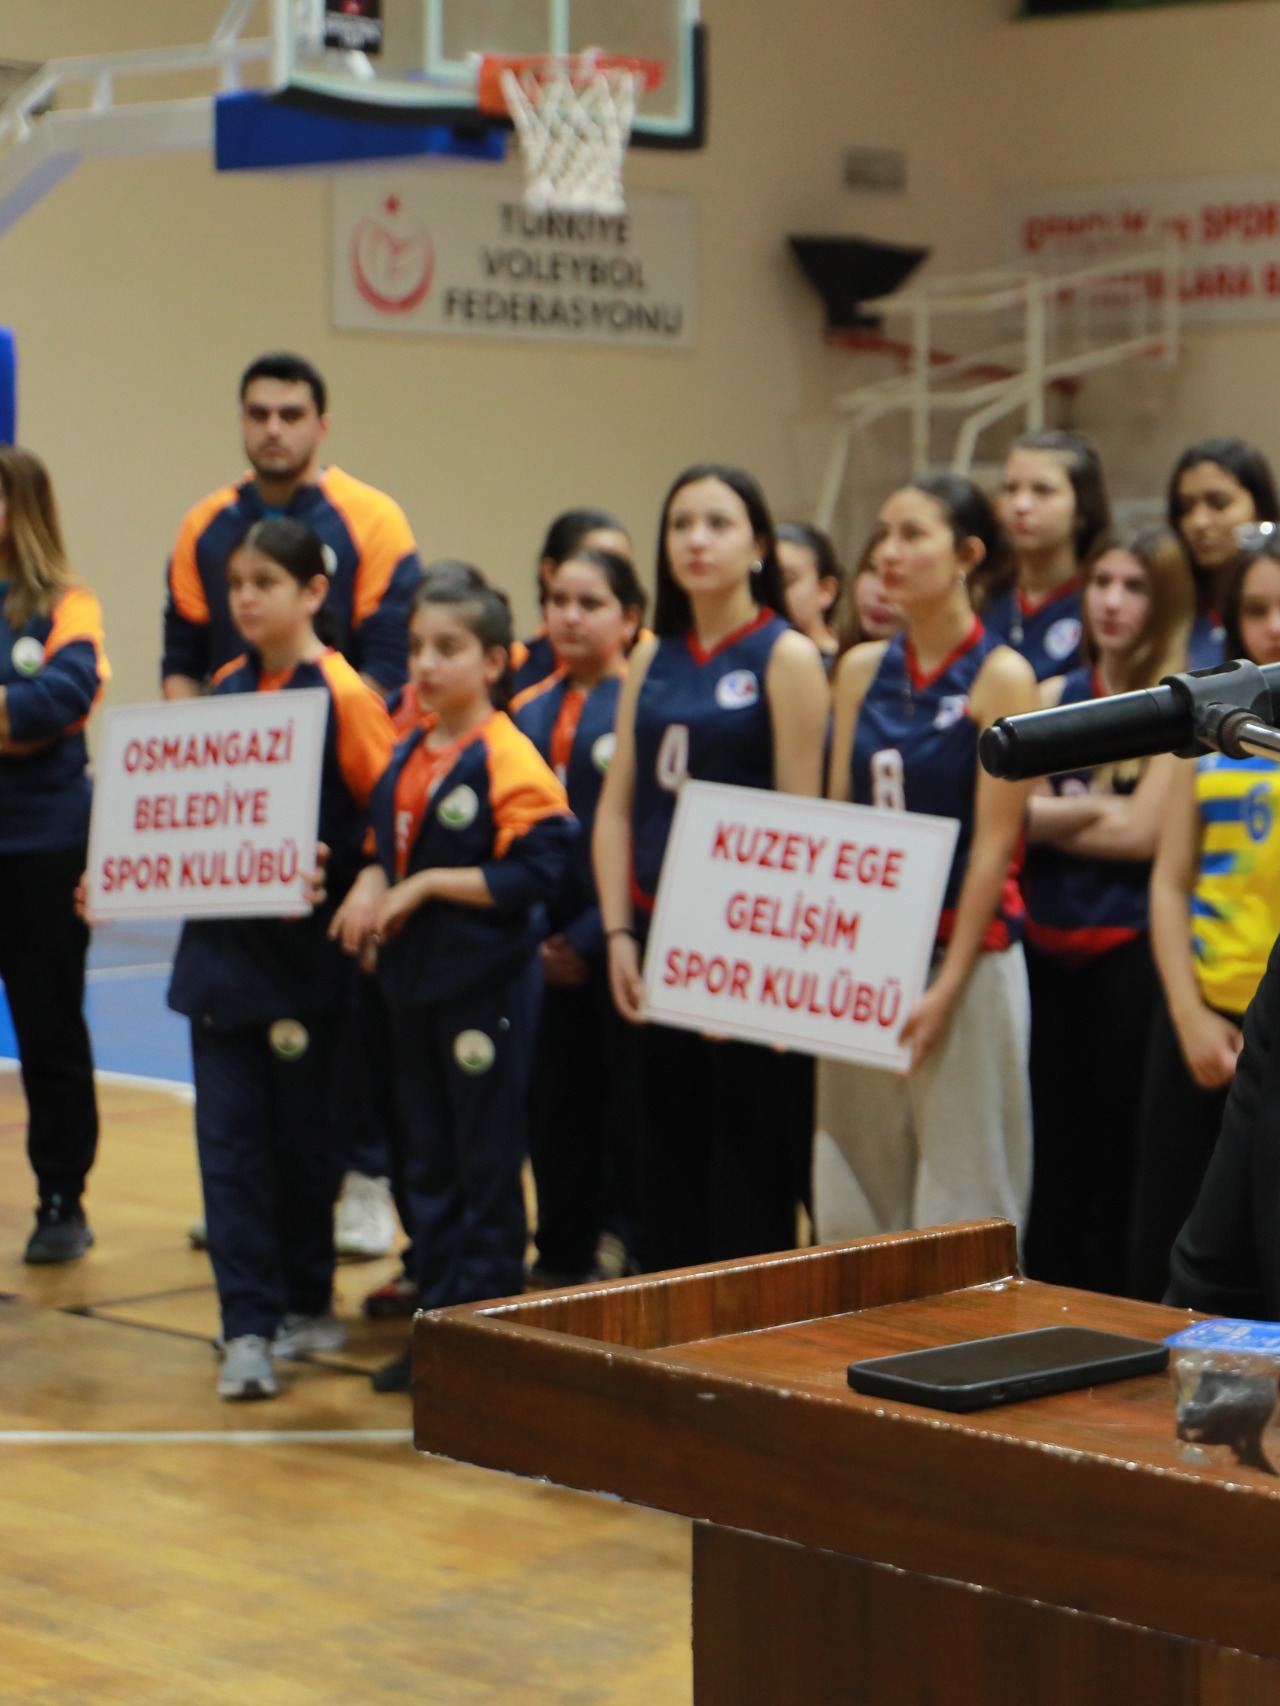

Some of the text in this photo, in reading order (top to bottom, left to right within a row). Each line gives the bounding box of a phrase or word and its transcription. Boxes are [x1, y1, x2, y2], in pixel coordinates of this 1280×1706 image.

[1201, 201, 1280, 243] SPOR
[483, 248, 647, 290] VOLEYBOL
[443, 287, 684, 335] FEDERASYONU
[123, 717, 295, 775] OSMANGAZİ
[134, 781, 270, 832] BELEDİYE
[1246, 781, 1273, 841] 6
[101, 838, 299, 893] SPOR KULÜBÜ
[711, 821, 904, 889] KUZEY EGE
[725, 891, 862, 951] GELİŞİM
[664, 949, 904, 1028] SPOR KULÜBÜ
